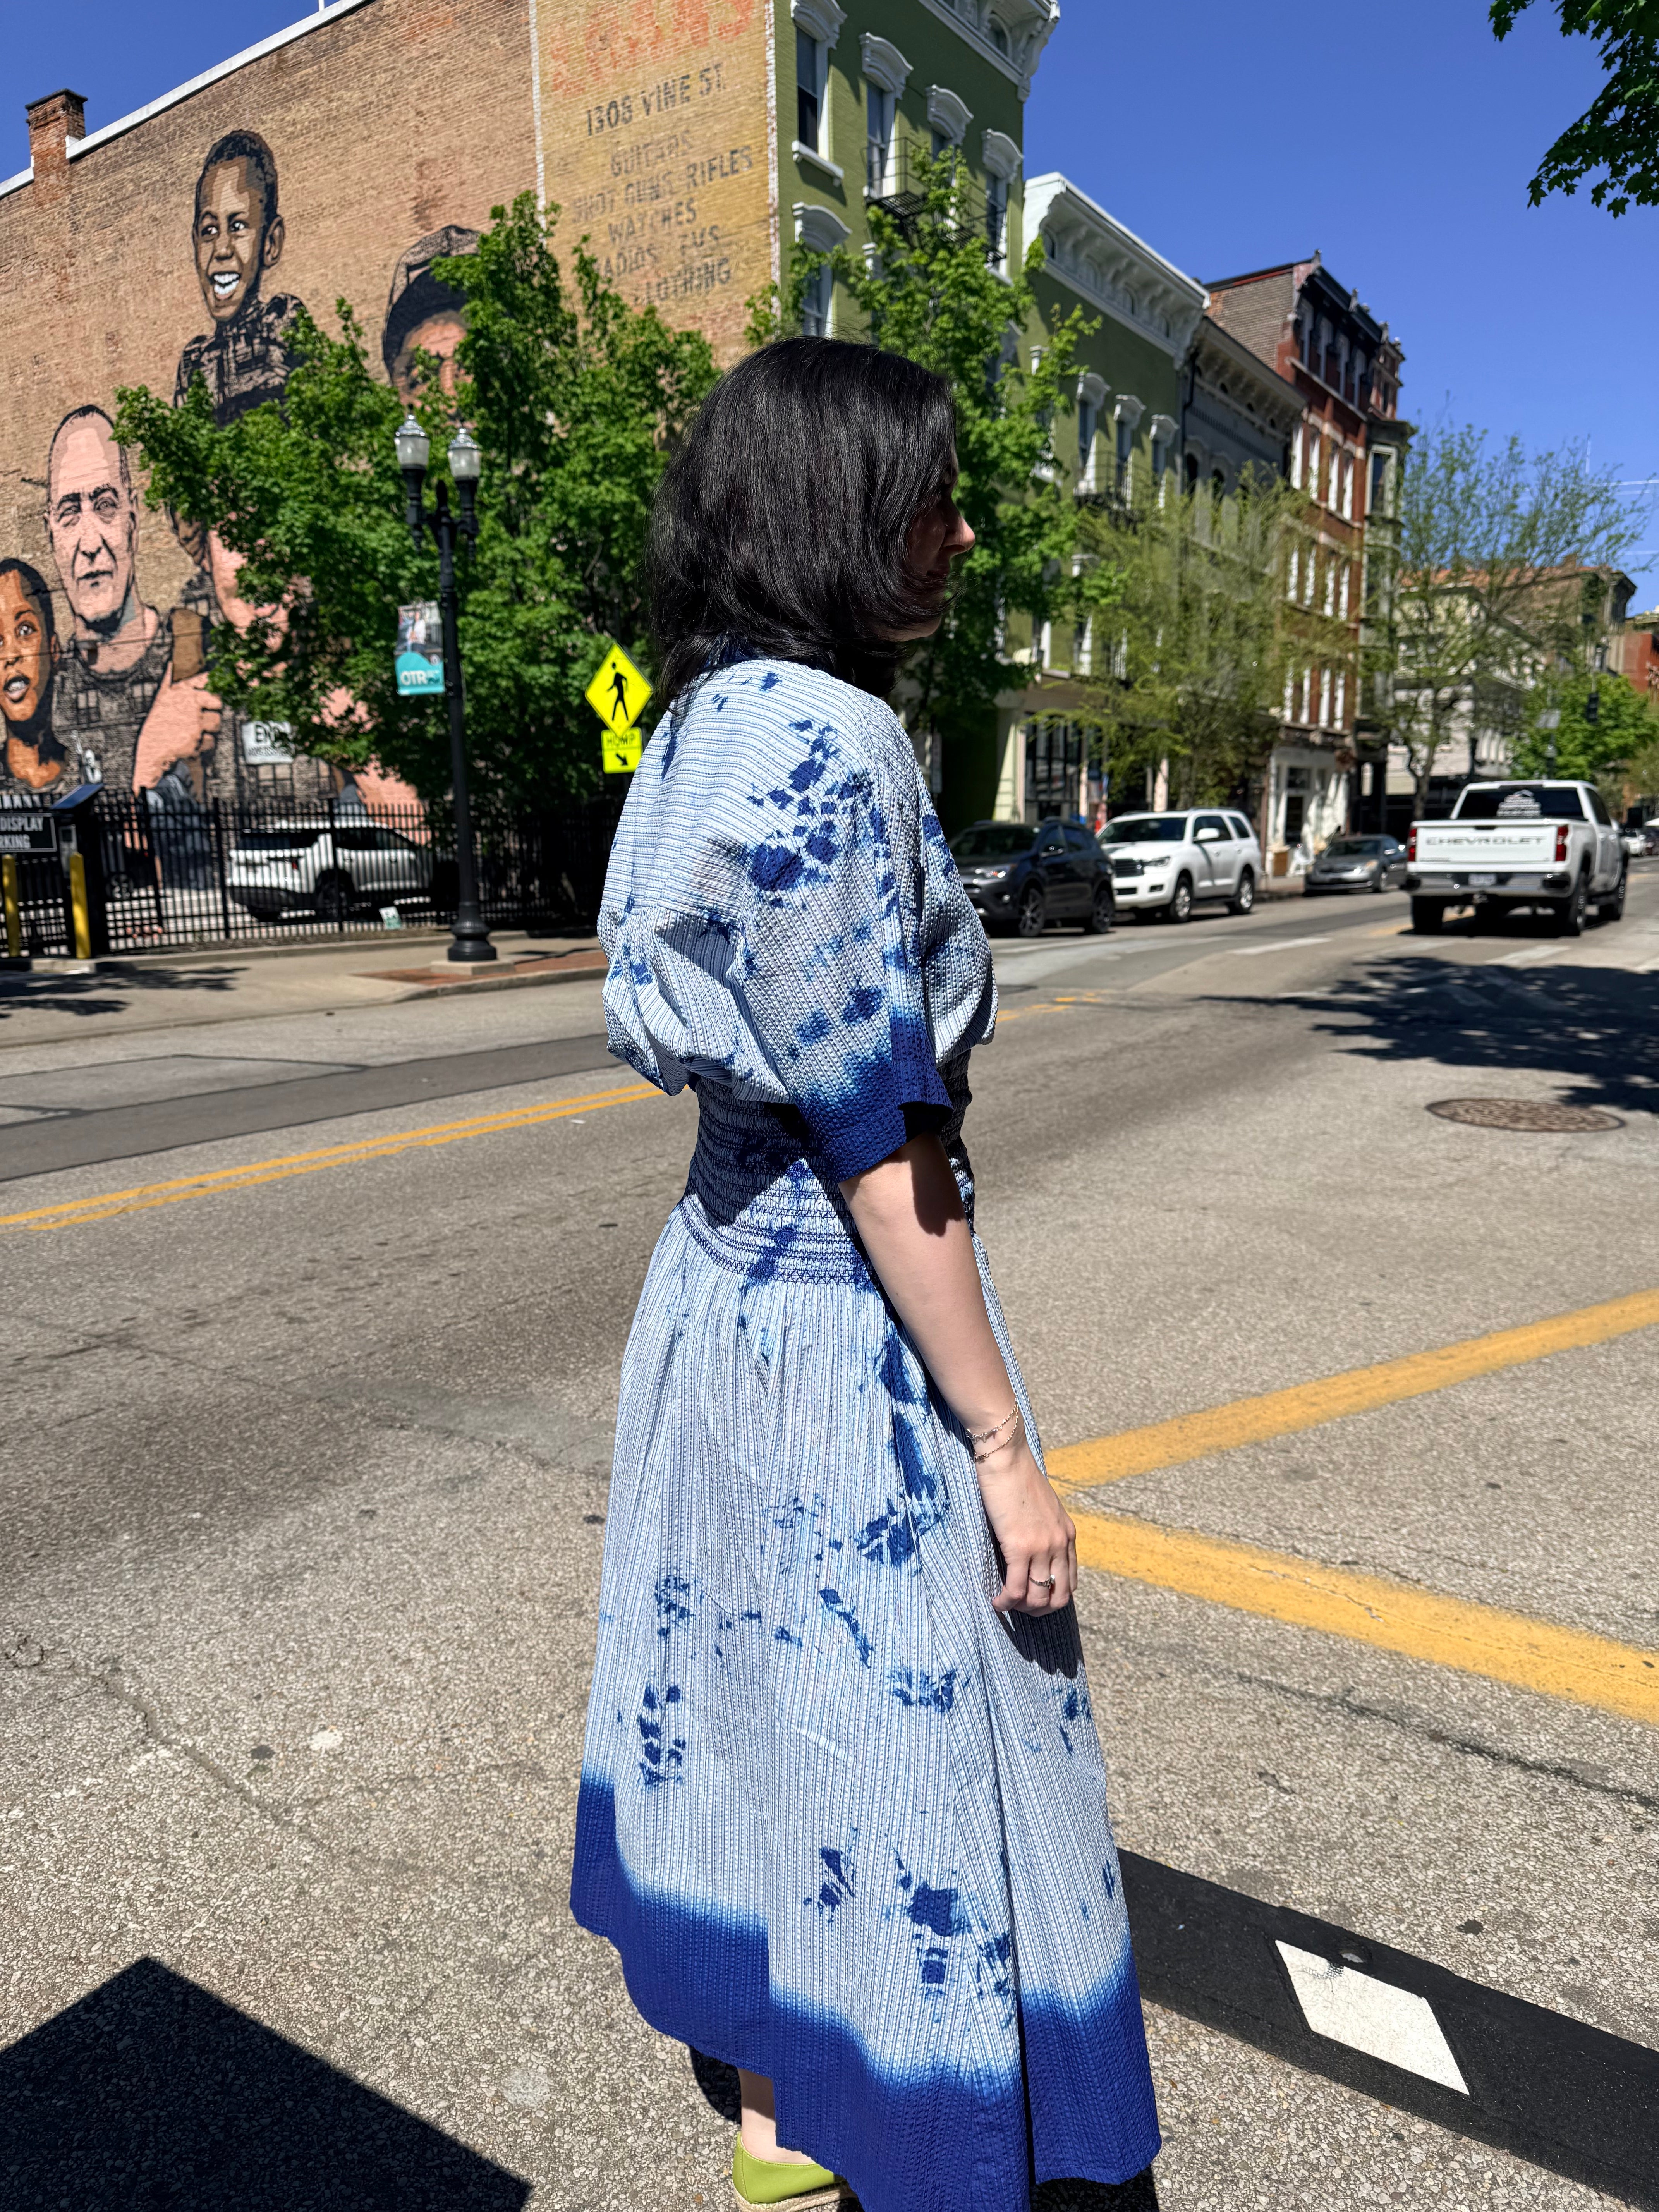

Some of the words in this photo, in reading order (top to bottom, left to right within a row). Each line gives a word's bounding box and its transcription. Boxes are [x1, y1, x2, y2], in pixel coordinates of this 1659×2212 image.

[639, 74, 690, 117] VINE
[685, 145, 753, 190] RIFLES
[608, 198, 696, 244] WATCHES
[400, 670, 427, 686] OTR
[0, 817, 44, 832] DISPLAY
[0, 834, 31, 849] RKING
[1426, 835, 1547, 845] CHEVROLET
